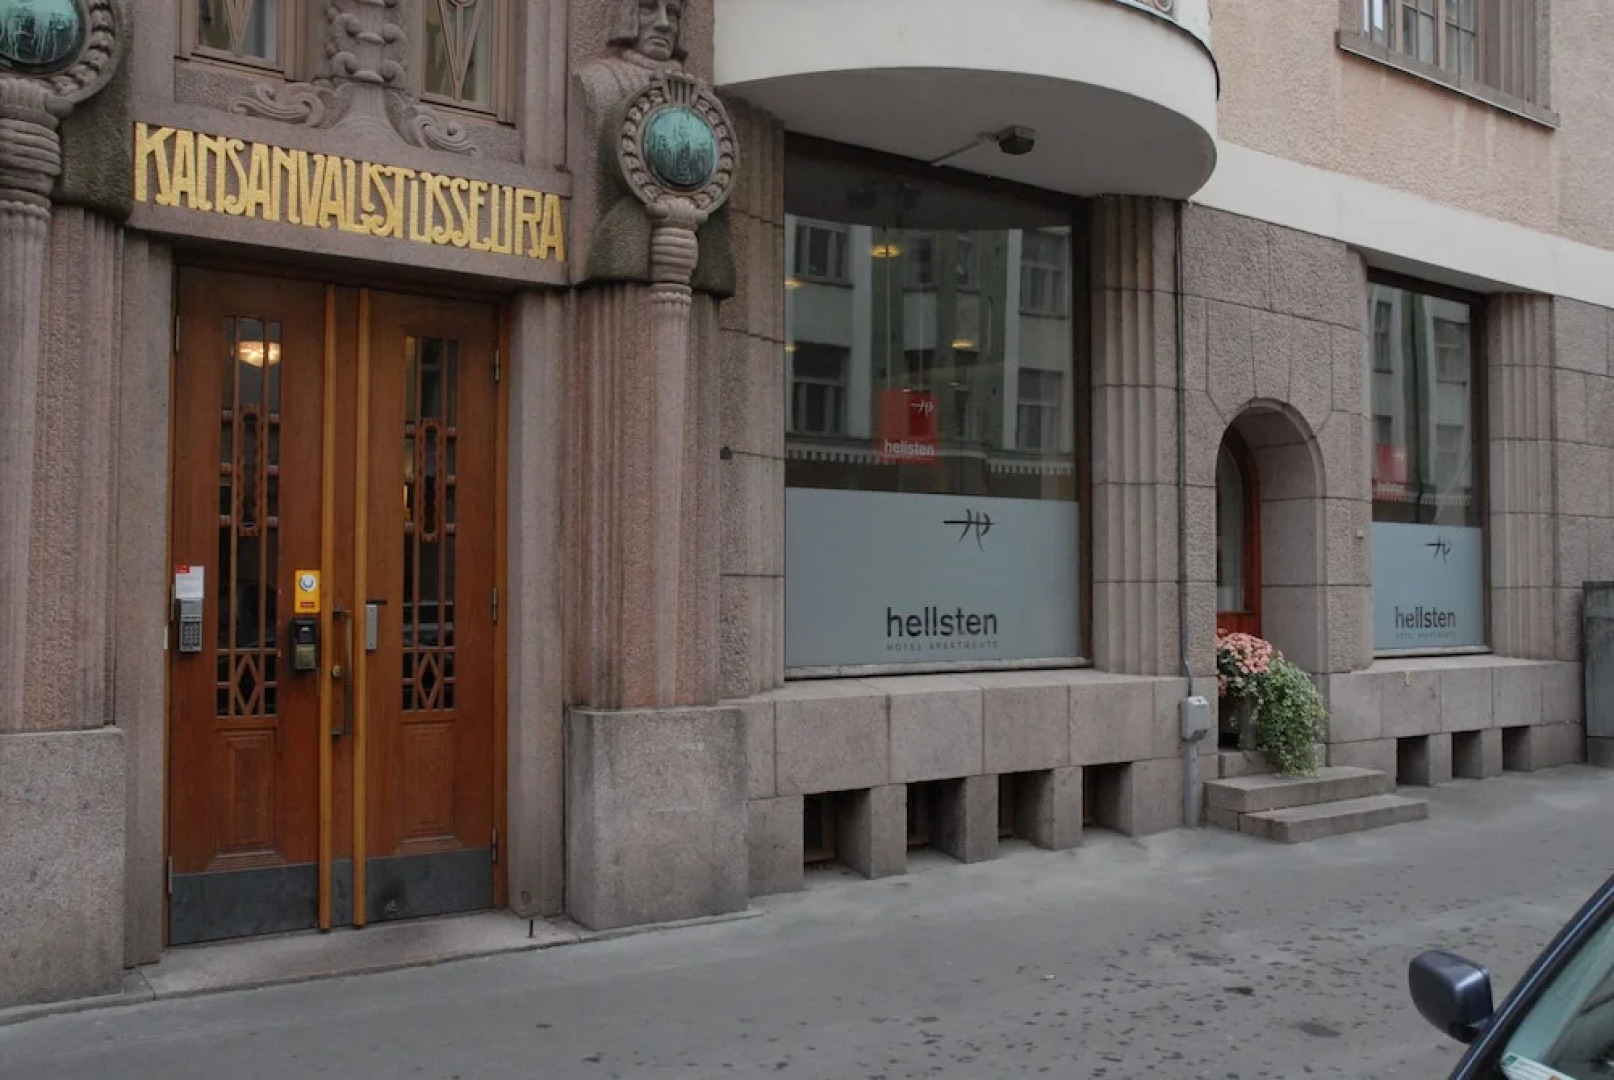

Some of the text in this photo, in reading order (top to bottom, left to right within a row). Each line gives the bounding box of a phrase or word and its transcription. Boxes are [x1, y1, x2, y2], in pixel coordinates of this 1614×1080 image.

[134, 121, 565, 262] KANSANVALISTUSSEURA
[884, 438, 935, 456] hellsten
[886, 606, 998, 637] hellsten
[1395, 606, 1456, 629] hellsten
[886, 642, 923, 652] HOTEL
